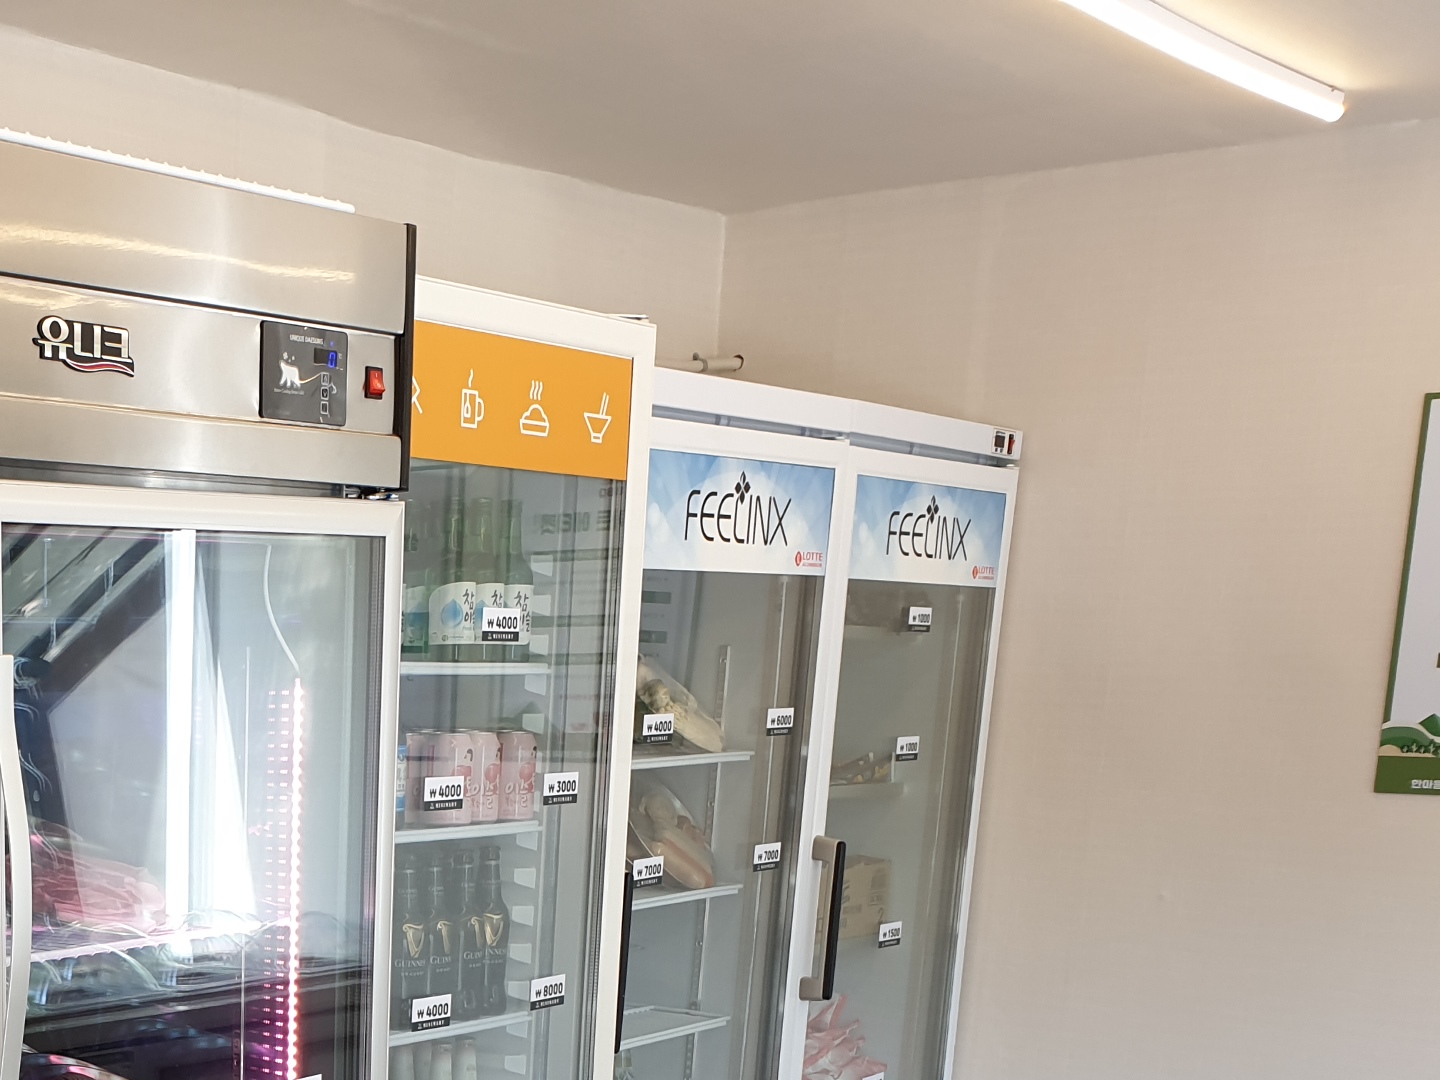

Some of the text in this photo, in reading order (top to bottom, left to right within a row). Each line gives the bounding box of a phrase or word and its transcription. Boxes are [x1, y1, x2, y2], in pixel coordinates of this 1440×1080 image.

[33, 315, 131, 361] 유니크
[683, 488, 792, 547] FEELINX
[885, 510, 972, 561] FEELINX
[802, 551, 823, 562] LOTTE
[978, 566, 994, 575] LOTTE
